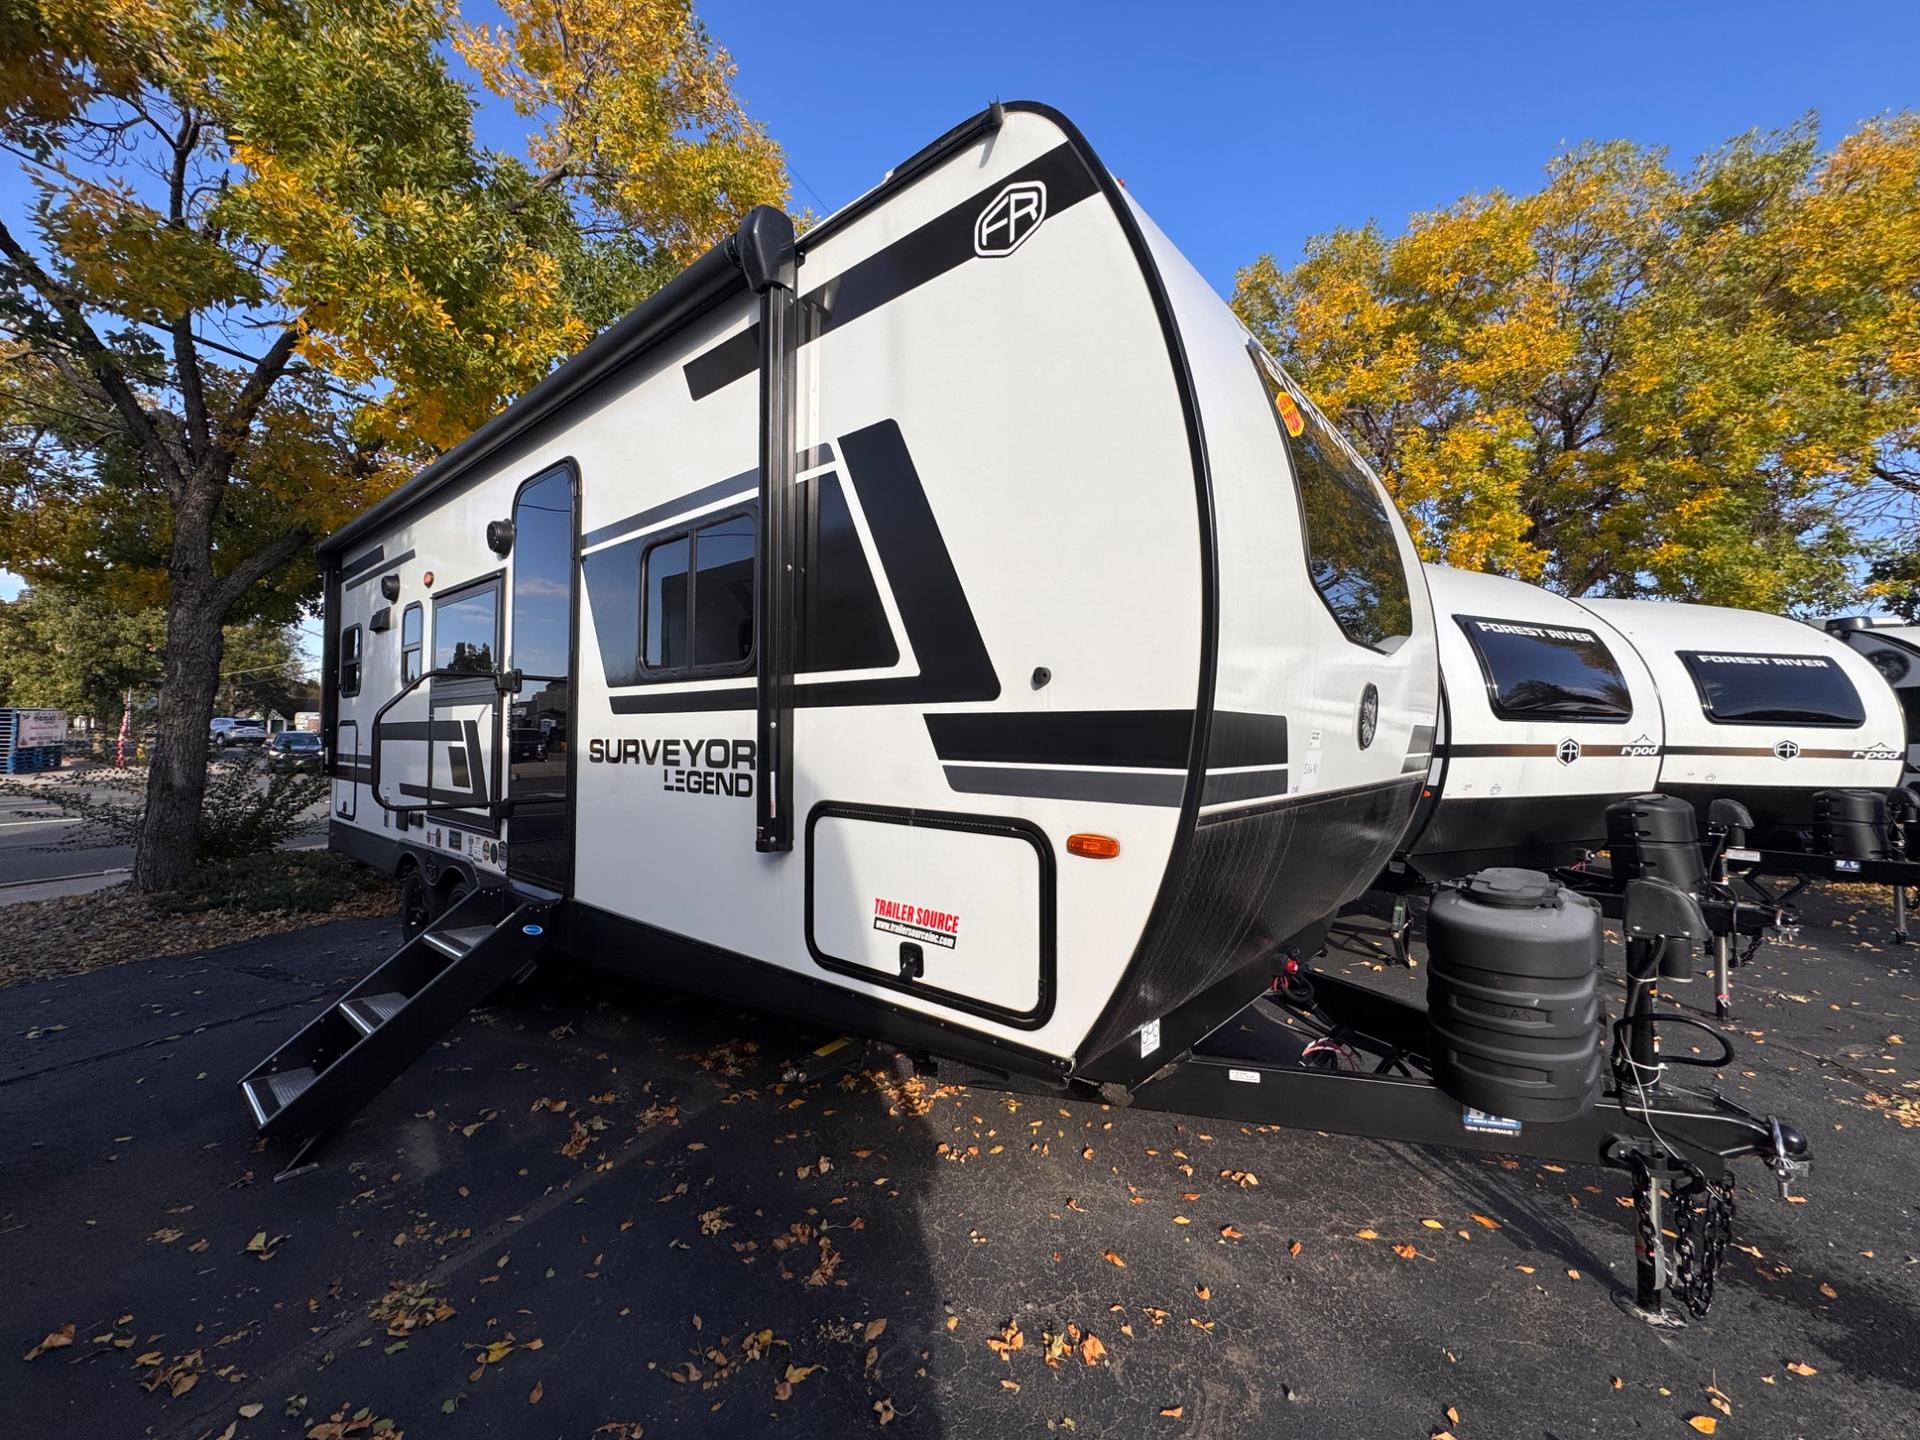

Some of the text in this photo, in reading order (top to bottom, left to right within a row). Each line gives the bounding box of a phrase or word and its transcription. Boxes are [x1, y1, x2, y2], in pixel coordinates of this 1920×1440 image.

[1475, 621, 1596, 643] FOREST RIVER
[1697, 655, 1829, 668] FOREST RIVER
[589, 738, 757, 770] SURVEYOR
[1620, 744, 1660, 757] r-pod
[1852, 750, 1900, 760] r-pod
[664, 769, 753, 798] LEGEND
[874, 897, 960, 934] TRAILER SOURCE
